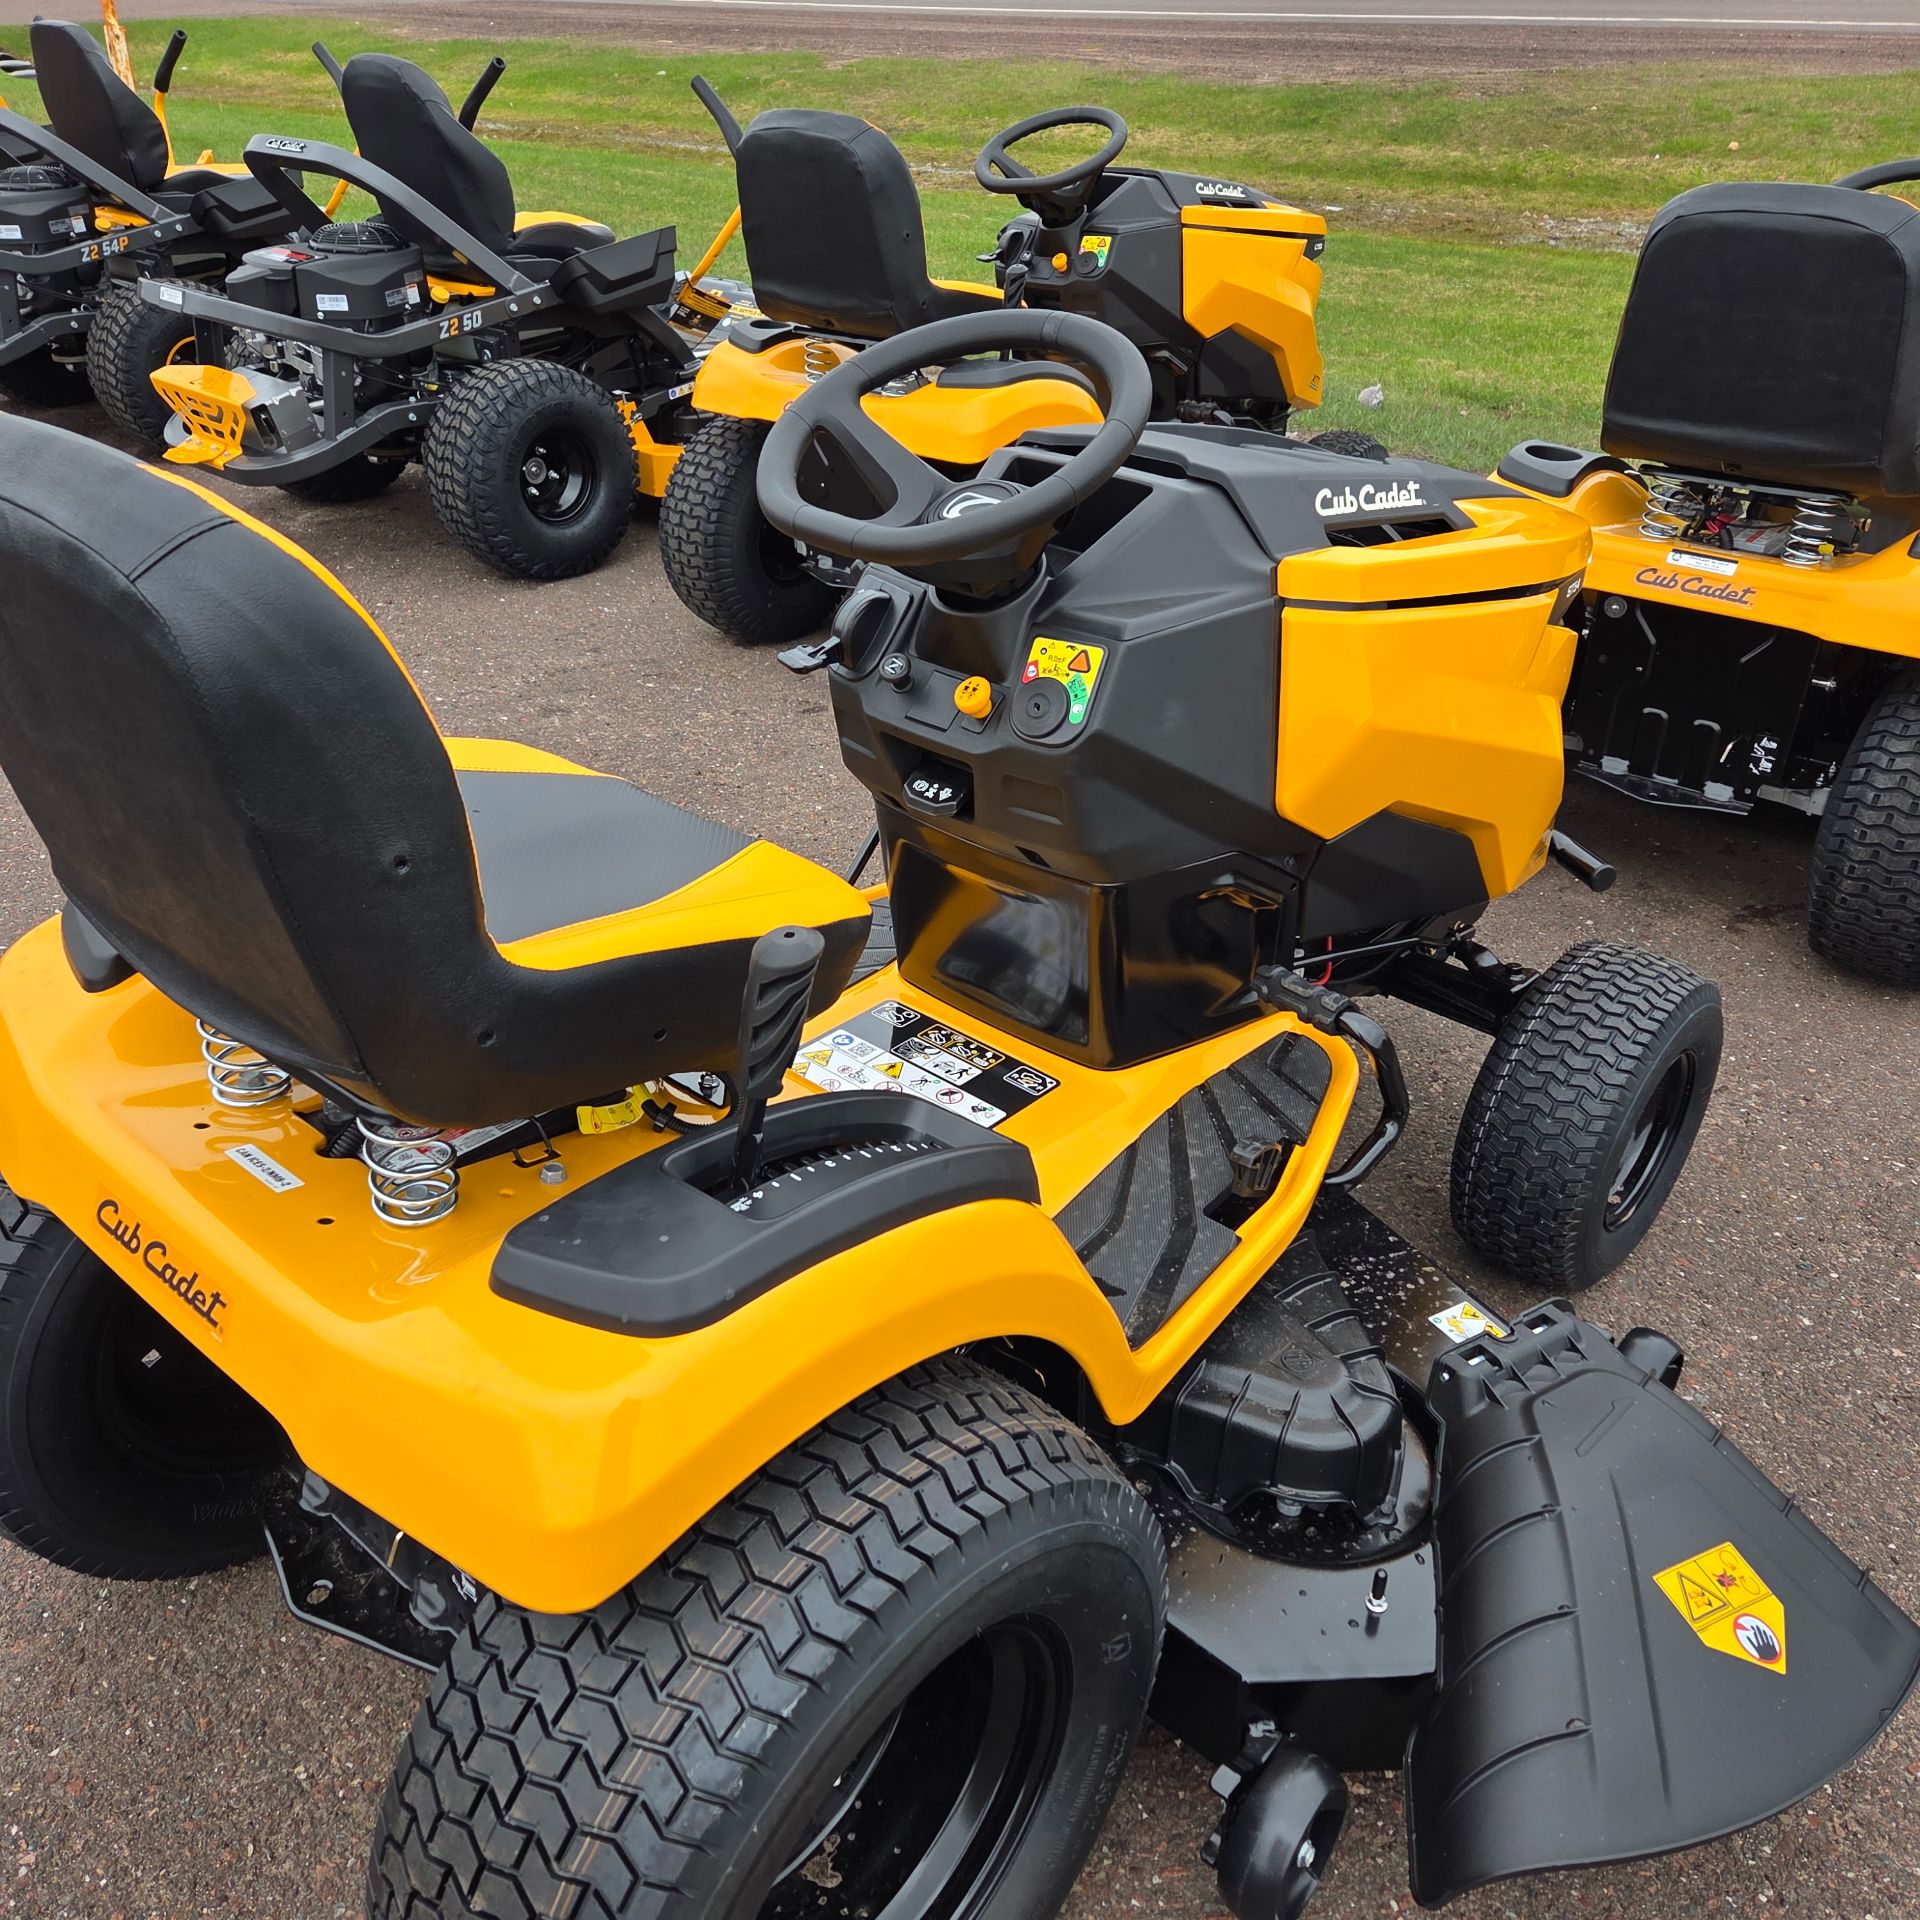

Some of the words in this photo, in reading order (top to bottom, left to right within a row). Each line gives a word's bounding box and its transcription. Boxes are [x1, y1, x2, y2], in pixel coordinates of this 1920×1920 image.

[1195, 182, 1215, 195] Cub
[1215, 184, 1246, 198] Cadet
[81, 244, 99, 263] Z2
[102, 236, 129, 256] 54P
[439, 317, 459, 340] Z2
[463, 310, 482, 332] 50
[1314, 486, 1358, 517] Cub
[1359, 480, 1423, 511] Cadet
[1635, 567, 1678, 589] Cub
[1680, 576, 1756, 605] Cadet
[96, 1199, 141, 1255] Cub
[143, 1240, 227, 1329] Cadet
